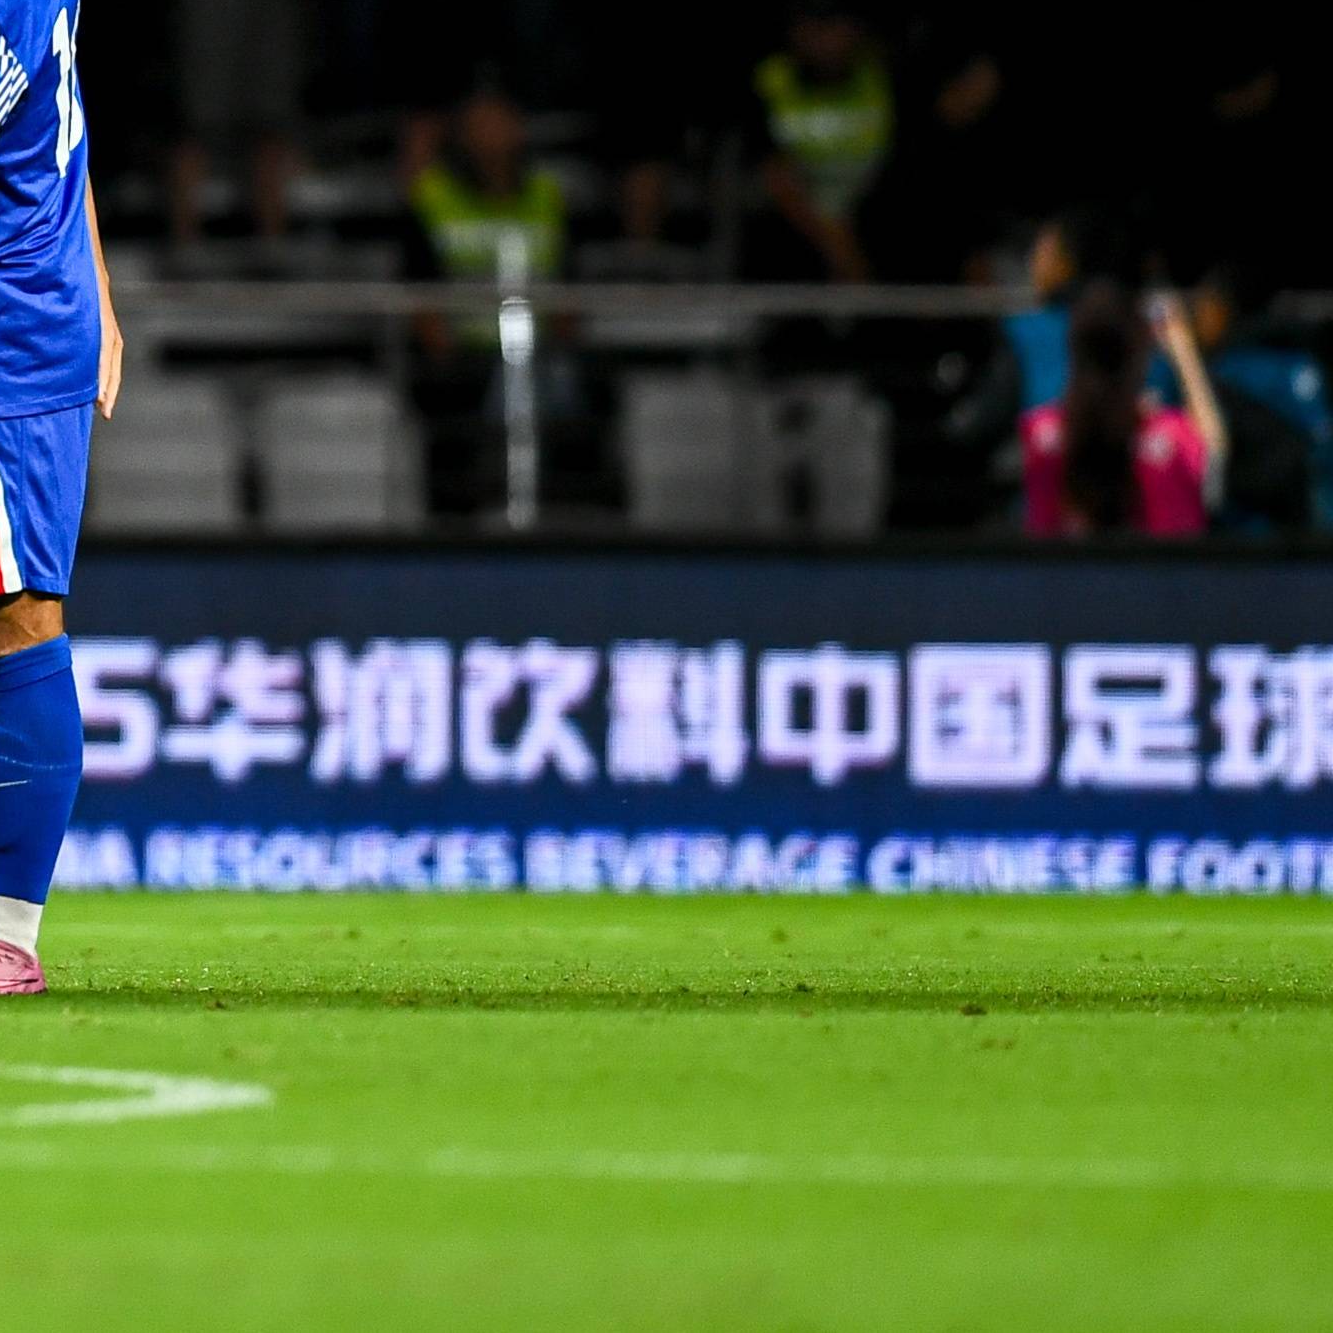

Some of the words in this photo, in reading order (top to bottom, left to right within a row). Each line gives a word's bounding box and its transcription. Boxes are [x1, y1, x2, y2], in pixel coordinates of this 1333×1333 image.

[145, 827, 519, 891] RESOURCES
[523, 829, 859, 894] BEVERAGE
[866, 833, 1136, 895] CHINESE
